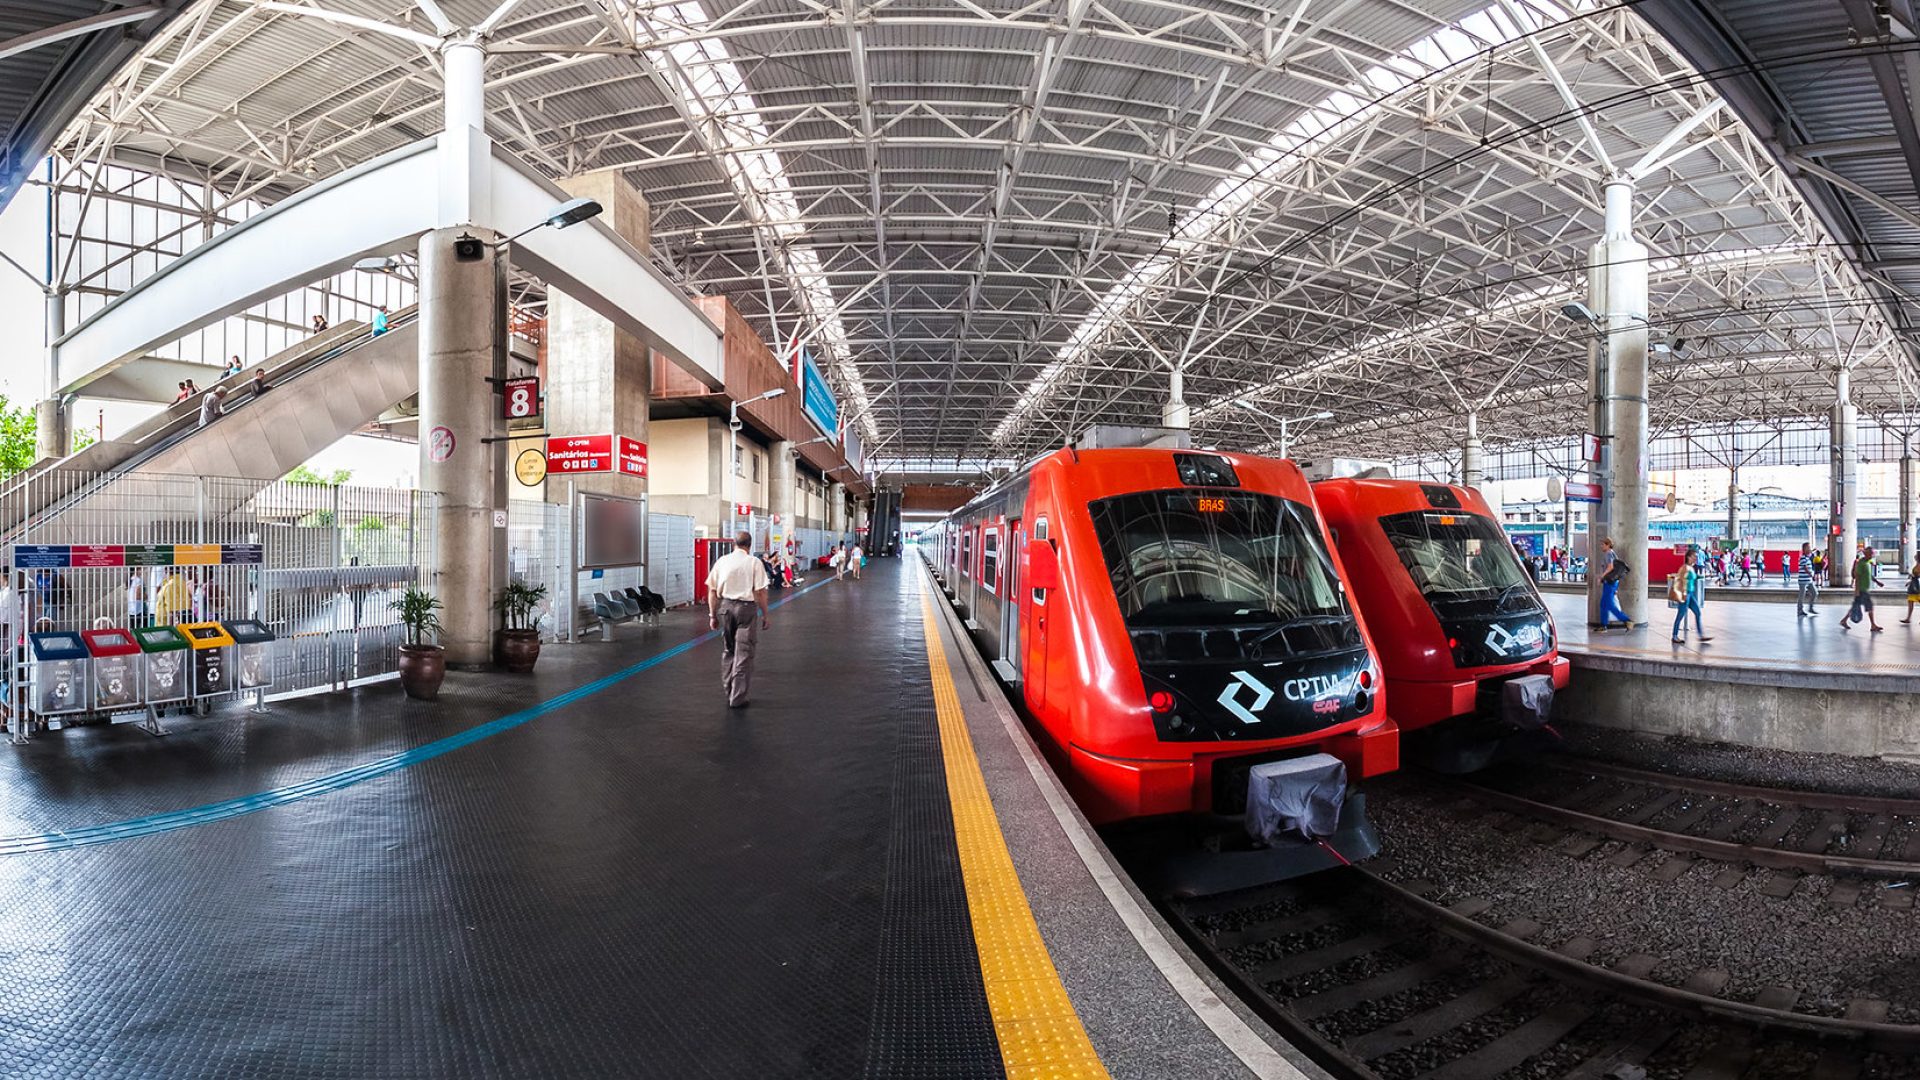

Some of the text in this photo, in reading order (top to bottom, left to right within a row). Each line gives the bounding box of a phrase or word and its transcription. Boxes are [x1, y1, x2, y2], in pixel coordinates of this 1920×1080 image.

[511, 389, 530, 417] 8
[549, 450, 589, 460] Sanitários
[1283, 674, 1341, 701] CPTM
